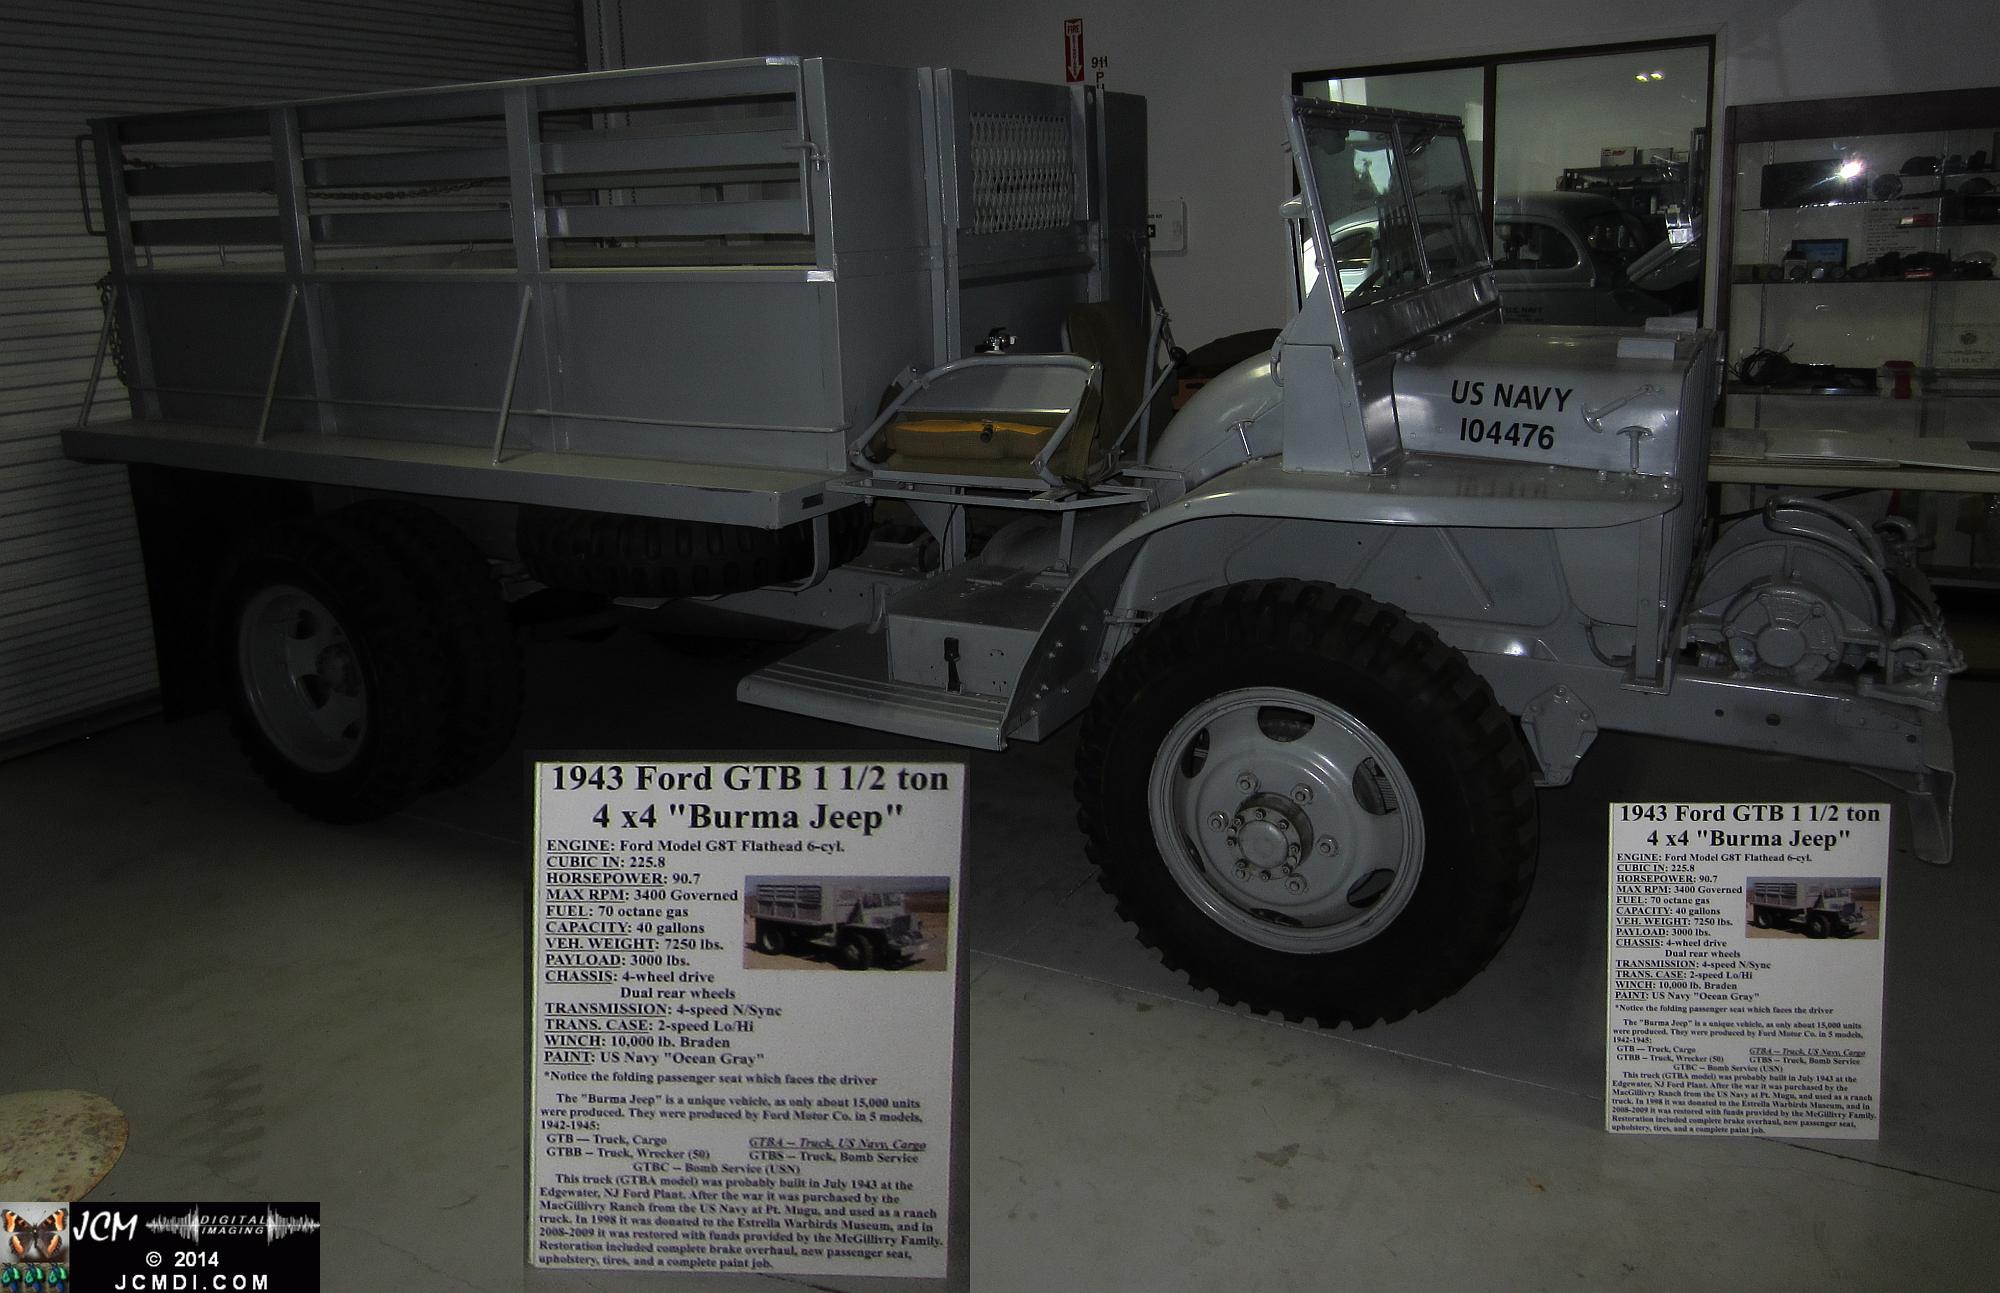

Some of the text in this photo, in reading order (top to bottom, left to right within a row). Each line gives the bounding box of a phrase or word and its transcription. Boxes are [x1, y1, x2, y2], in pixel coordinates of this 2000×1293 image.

[1067, 25, 1080, 34] FIRE
[1091, 56, 1108, 68] 911
[1451, 379, 1573, 412] US NAVY
[1459, 417, 1555, 450] 104476
[552, 766, 949, 792] 1943 Ford GTB 1 1/2 ton
[592, 803, 902, 835] 4 x4 "Burma Jeep"
[1620, 805, 1880, 822] 1943 Ford GTB 1 1/2 ton
[1646, 830, 1850, 850] 4 x4 "Burma Jeep"
[546, 839, 844, 855] ENGINE: Ford Model G8T Flathead 6-cyl.
[546, 856, 665, 867] CUBIC IN: 225.8
[545, 872, 700, 884] HORSEPOWER: 90.7
[546, 889, 738, 901] MAX RPM: 3400 Governed
[546, 905, 688, 920] FUEL: 70 octane gas
[1688, 907, 1720, 916] gallons
[545, 921, 704, 936] CAPACITY: 40 gallons
[545, 938, 723, 950] VEH. WEIGHT: 7250 lbs.
[545, 954, 689, 966] PAYLOAD: 3000 lbs.
[1701, 961, 1735, 969] 4-speed
[545, 970, 714, 982] CHASSIS: 4-wheel drive
[1689, 971, 1723, 980] 2-speed
[620, 988, 653, 998] Dual
[690, 989, 735, 999] wheels
[543, 1002, 782, 1018] TRANSMISSION: 4-speed N/Sync
[544, 1019, 753, 1033] TRANS. CASE: 2-speed Lo/Hi
[543, 1035, 606, 1045] WINCH:
[658, 1037, 675, 1047] lb.
[679, 1037, 730, 1047] Braden
[543, 1051, 763, 1067] PAINT: US Navy "Ocean Gray"
[590, 1072, 609, 1081] the
[612, 1072, 653, 1083] folding
[656, 1075, 715, 1084] passenger
[718, 1074, 742, 1083] seat
[745, 1074, 781, 1084] which
[785, 1075, 814, 1084] faces
[818, 1076, 836, 1085] the
[839, 1076, 877, 1085] driver
[555, 1094, 578, 1102] The
[665, 1096, 674, 1104] is
[687, 1096, 725, 1107] unique
[788, 1098, 813, 1108] only
[816, 1098, 849, 1107] about
[892, 1100, 920, 1108] units
